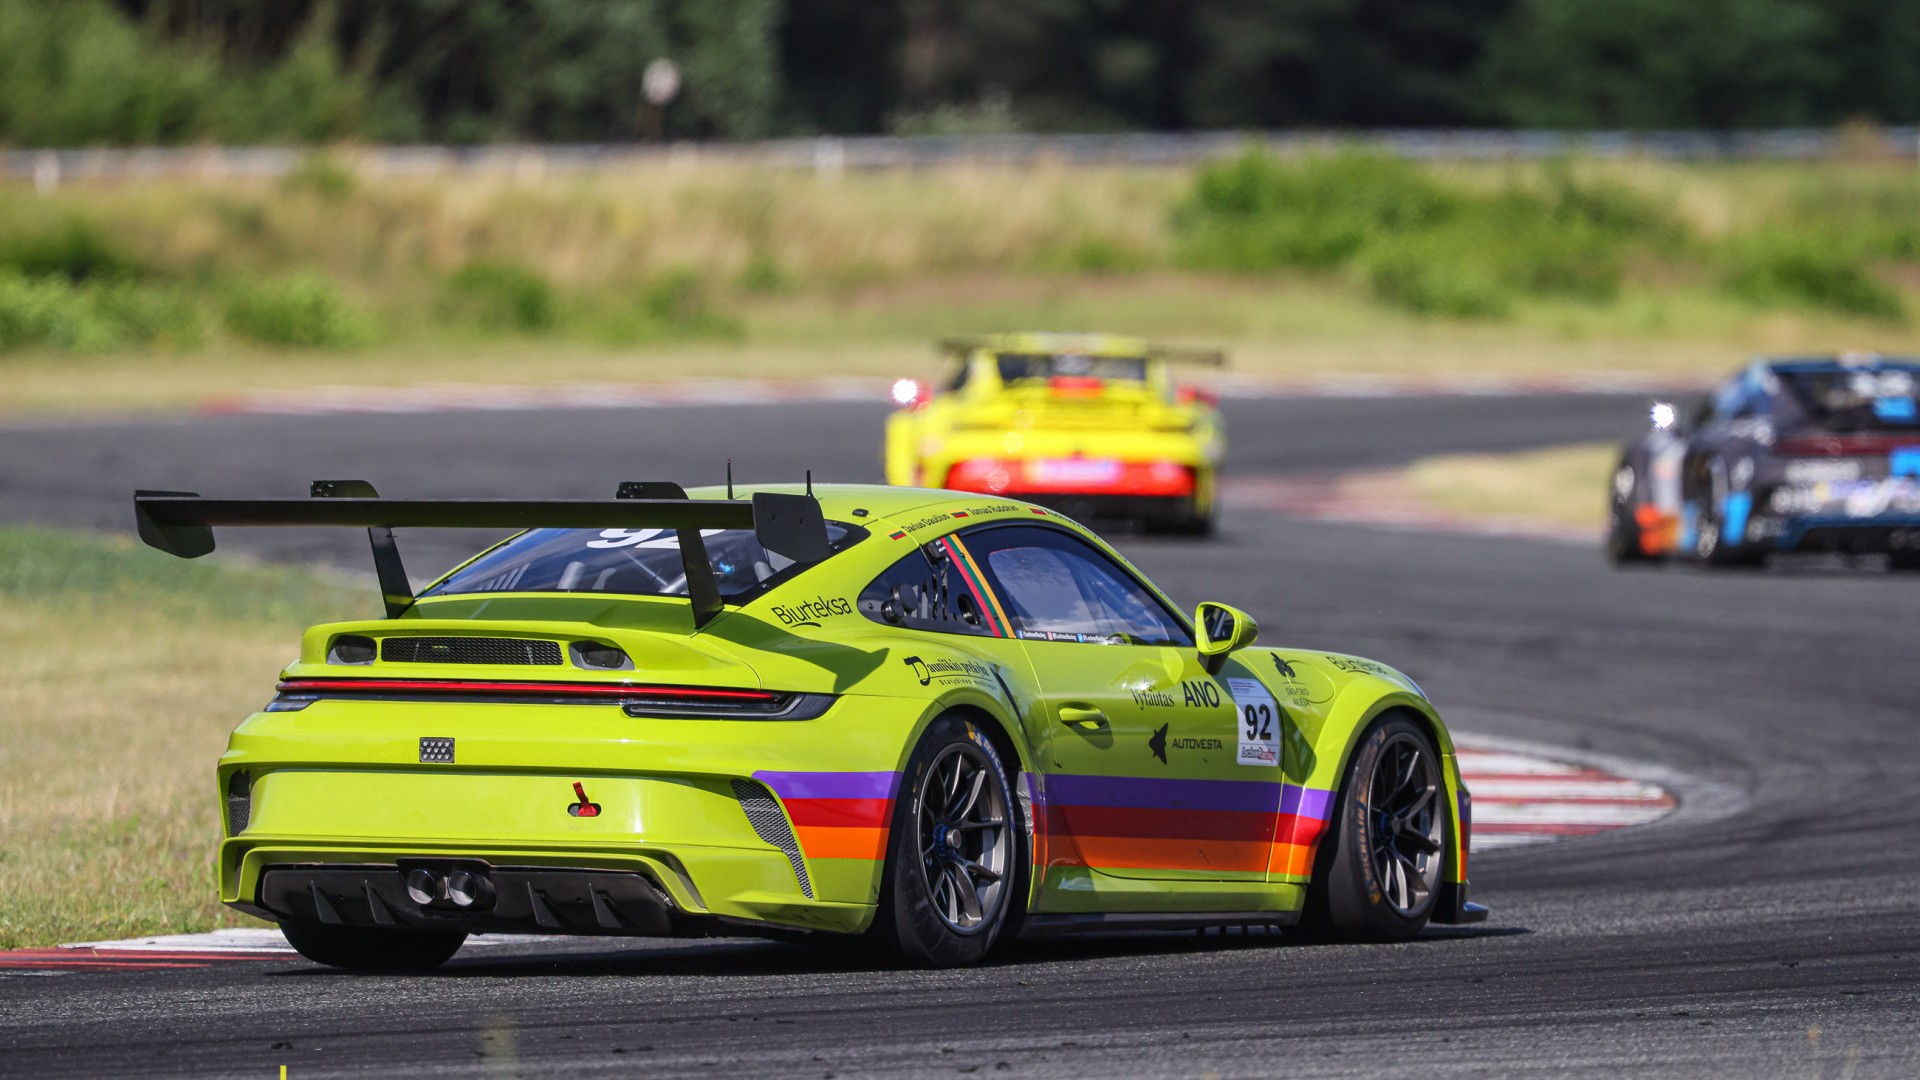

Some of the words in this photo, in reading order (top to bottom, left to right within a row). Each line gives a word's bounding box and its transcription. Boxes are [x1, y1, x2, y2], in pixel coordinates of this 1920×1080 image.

[901, 521, 926, 533] Darius
[771, 595, 852, 625] Biurteksa
[1130, 688, 1175, 711] Vytautas
[1181, 681, 1220, 708] ANO
[1244, 703, 1272, 741] 92
[1172, 738, 1222, 750] AUTOVESTA
[1358, 808, 1374, 881] MICHELIN
